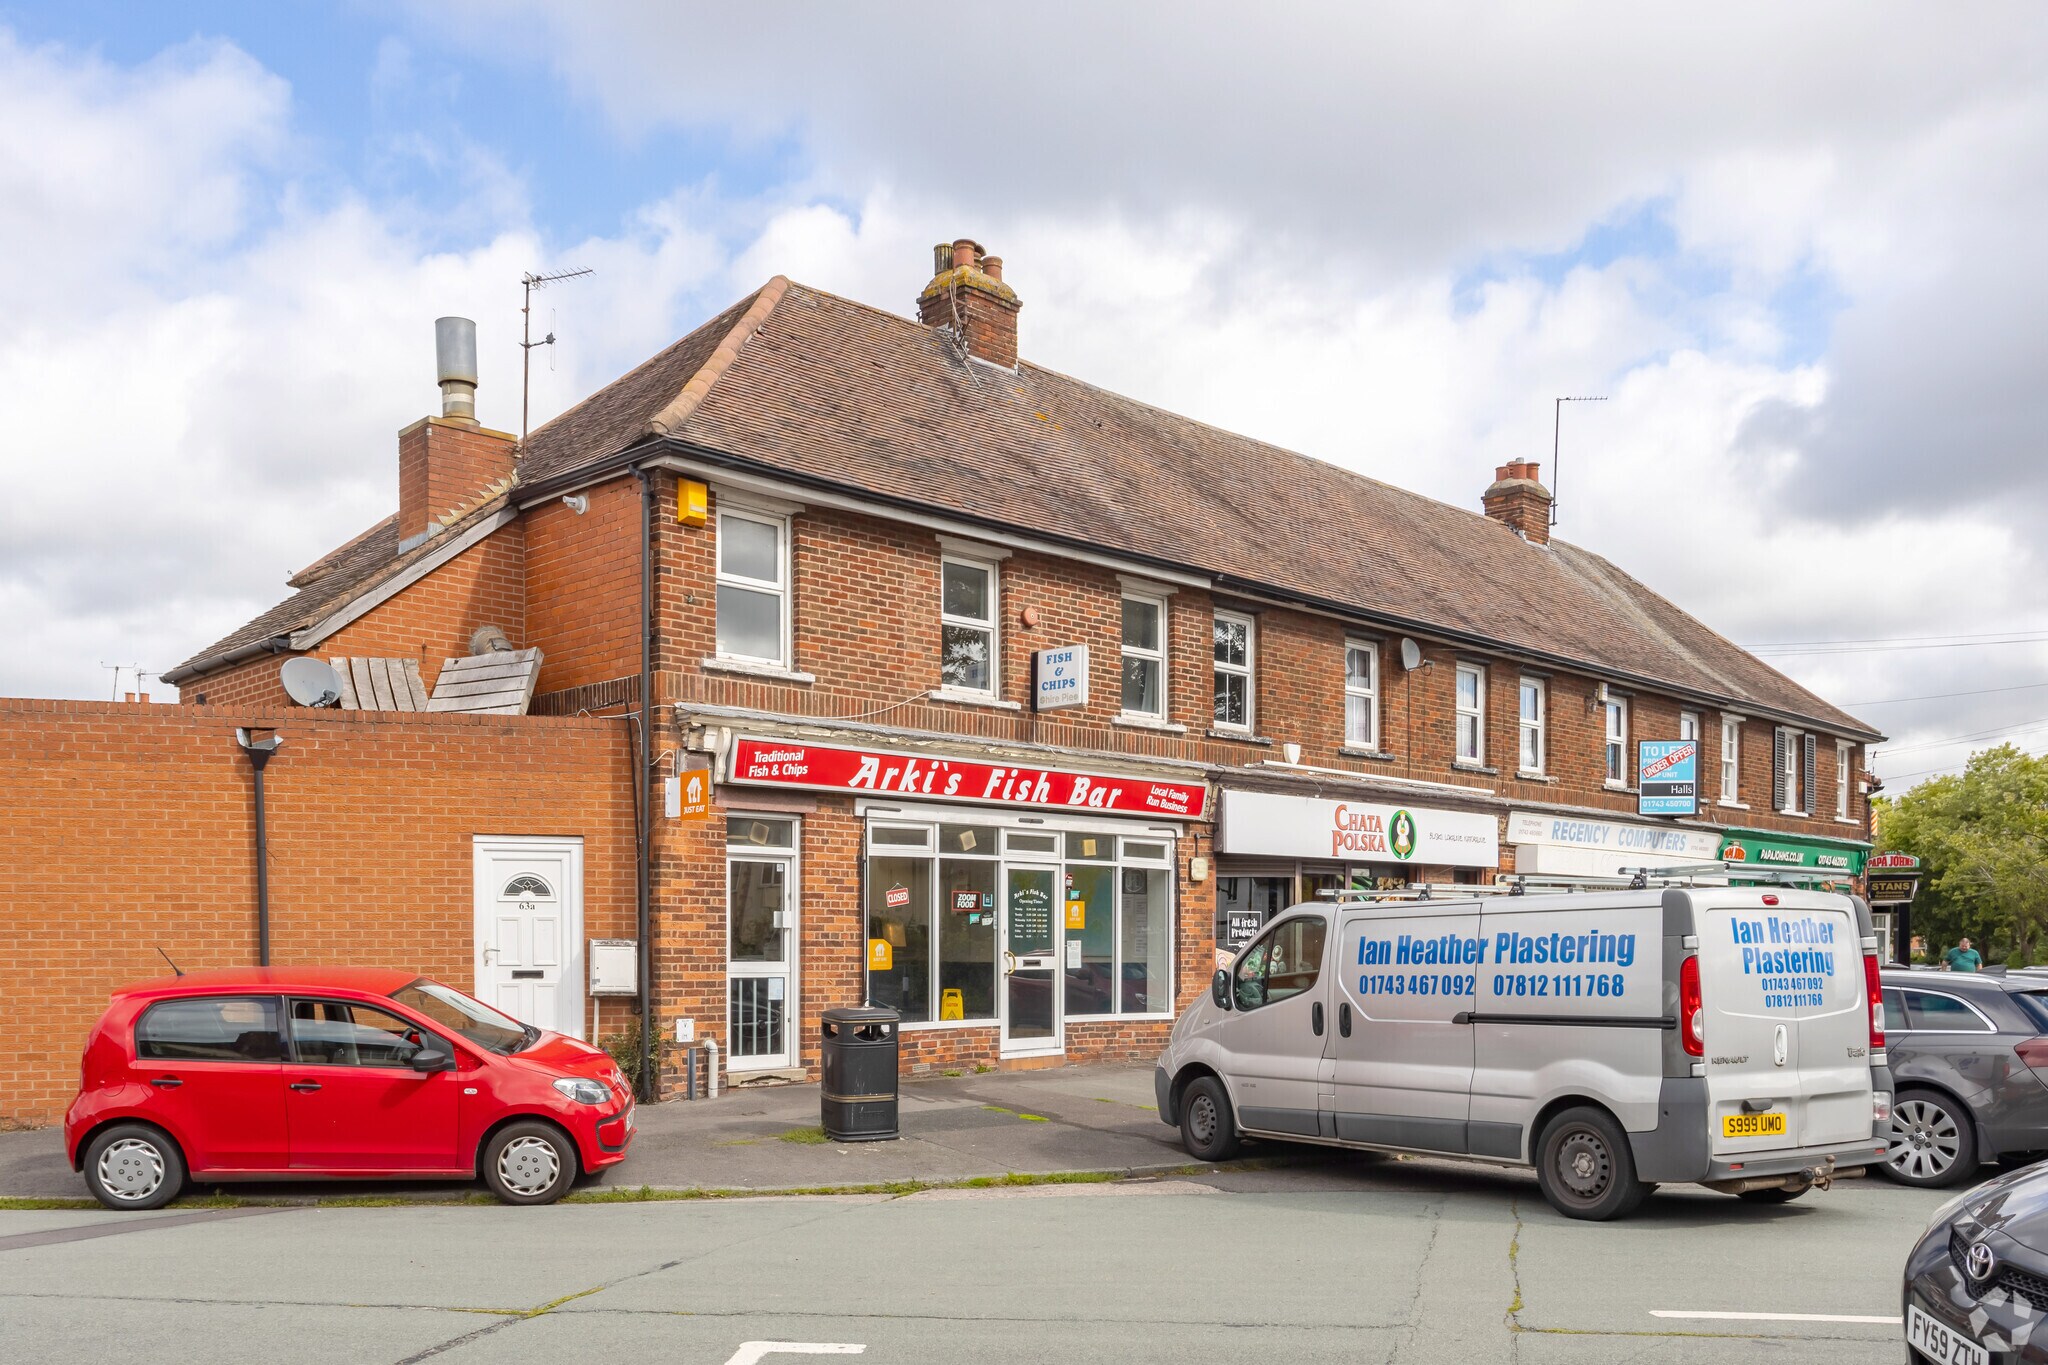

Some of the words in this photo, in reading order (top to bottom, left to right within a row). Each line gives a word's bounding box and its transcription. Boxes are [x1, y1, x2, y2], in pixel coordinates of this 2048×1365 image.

[1046, 652, 1073, 665] FISH
[1054, 666, 1064, 677] &
[1041, 678, 1076, 691] CHIPS
[754, 749, 805, 763] Traditional
[1643, 745, 1659, 757] TO
[1643, 759, 1670, 778] UNDER
[1668, 745, 1694, 764] OFFER
[748, 764, 769, 777] Fish
[771, 763, 780, 776] &
[782, 763, 809, 777] Chips
[982, 768, 1051, 804] Fish
[1067, 776, 1122, 809] Bar
[1150, 784, 1169, 797] Local
[1167, 789, 1190, 804] Family
[1670, 784, 1693, 794] Halls
[684, 805, 695, 815] JUST
[695, 804, 706, 813] EAT
[1146, 795, 1160, 807] Run
[1160, 798, 1189, 813] Business
[1551, 820, 1610, 844] REGENCY
[1618, 828, 1687, 851] COMPUTERS
[1868, 855, 1887, 867] PAPA
[1871, 882, 1910, 891] STANS
[887, 892, 908, 904] CLOSED
[957, 893, 977, 901] ZOOM
[519, 901, 536, 910] 63a
[1231, 917, 1240, 927] All
[1241, 917, 1258, 927] fresh
[1731, 917, 1764, 944] Ian
[1767, 917, 1834, 944] Heather
[1357, 936, 1391, 965] Ian
[1395, 934, 1489, 965] Heather
[1494, 929, 1636, 967] Plastering
[1742, 947, 1835, 976] Plastering
[1359, 975, 1405, 995] 01743
[1493, 975, 1548, 997] 07812
[1762, 978, 1789, 991] 01743
[1765, 995, 1793, 1008] 07812
[1711, 1055, 1749, 1066] RENAULT
[1729, 1117, 1758, 1133] S999
[1760, 1116, 1782, 1131] UMO
[1913, 1312, 1948, 1359] FY59
[1952, 1336, 1981, 1365] ZTH
